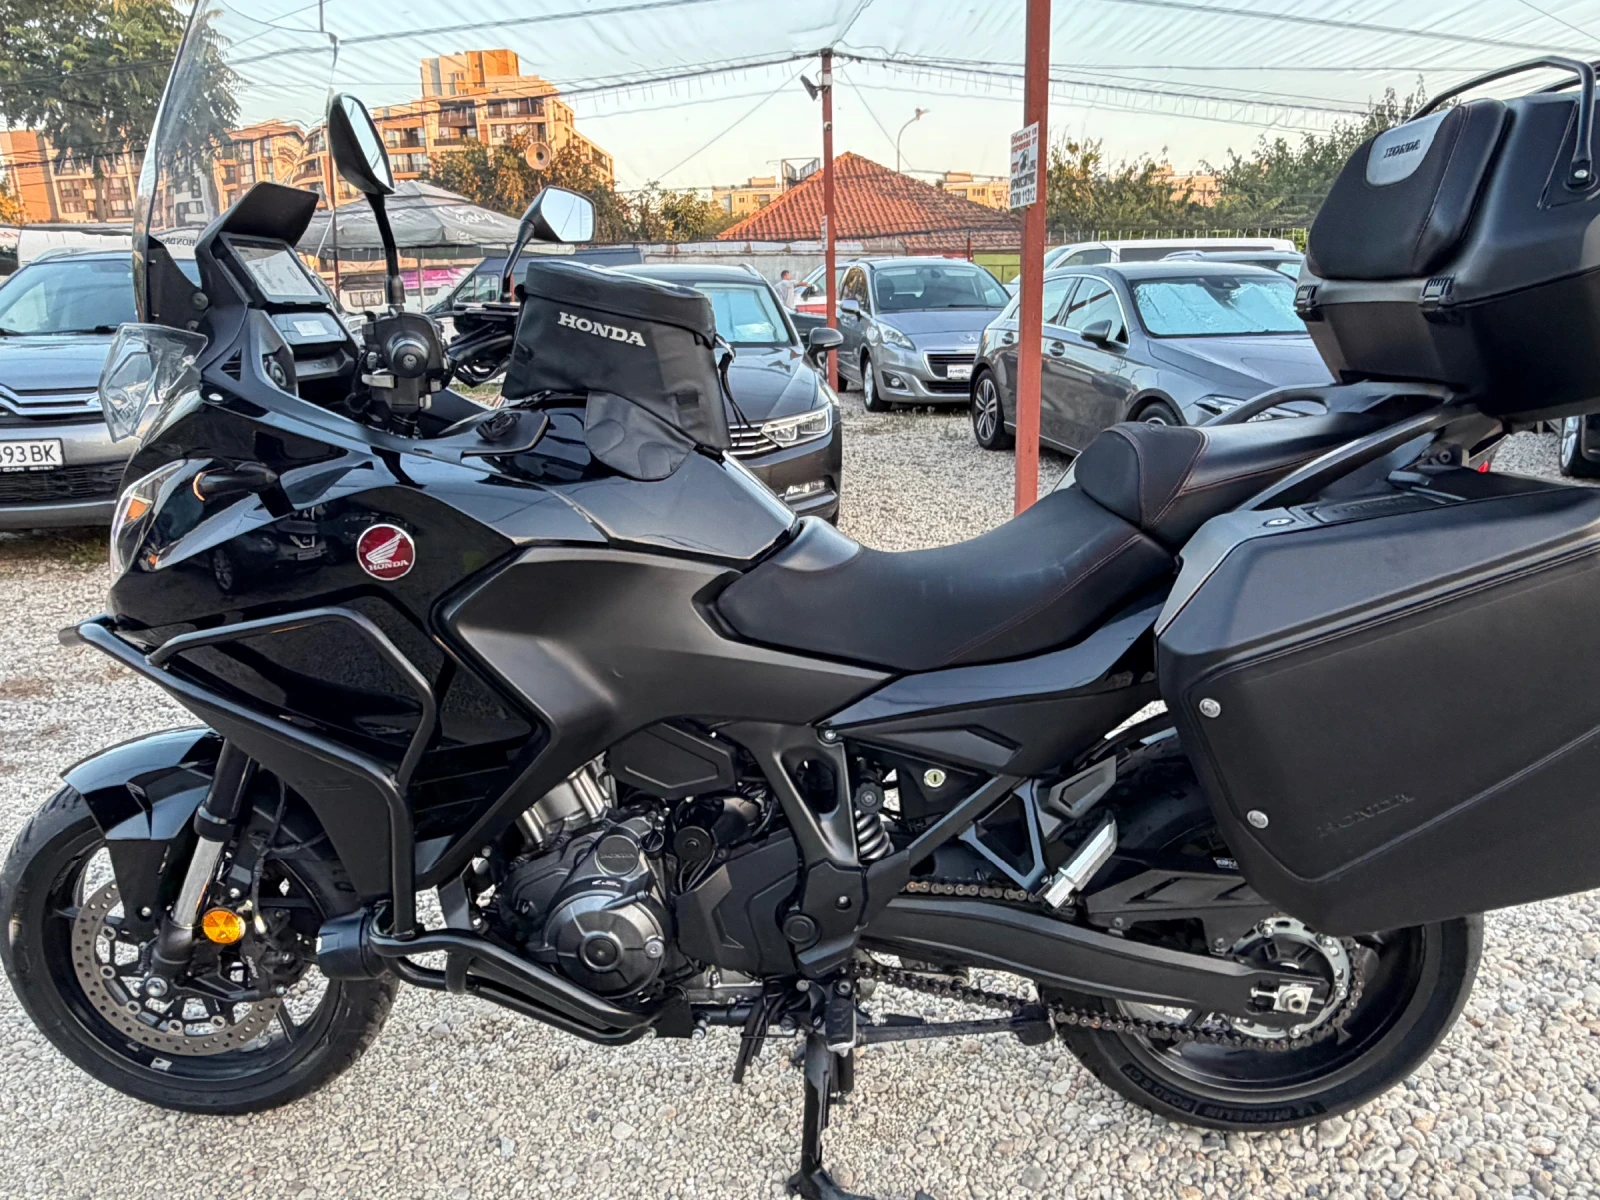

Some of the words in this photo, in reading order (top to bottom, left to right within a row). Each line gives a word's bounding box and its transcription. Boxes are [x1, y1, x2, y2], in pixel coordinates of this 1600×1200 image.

[557, 311, 647, 347] HONDA
[0, 445, 27, 464] 93
[368, 560, 410, 571] HONDA
[1203, 1106, 1292, 1122] MICHELIN
